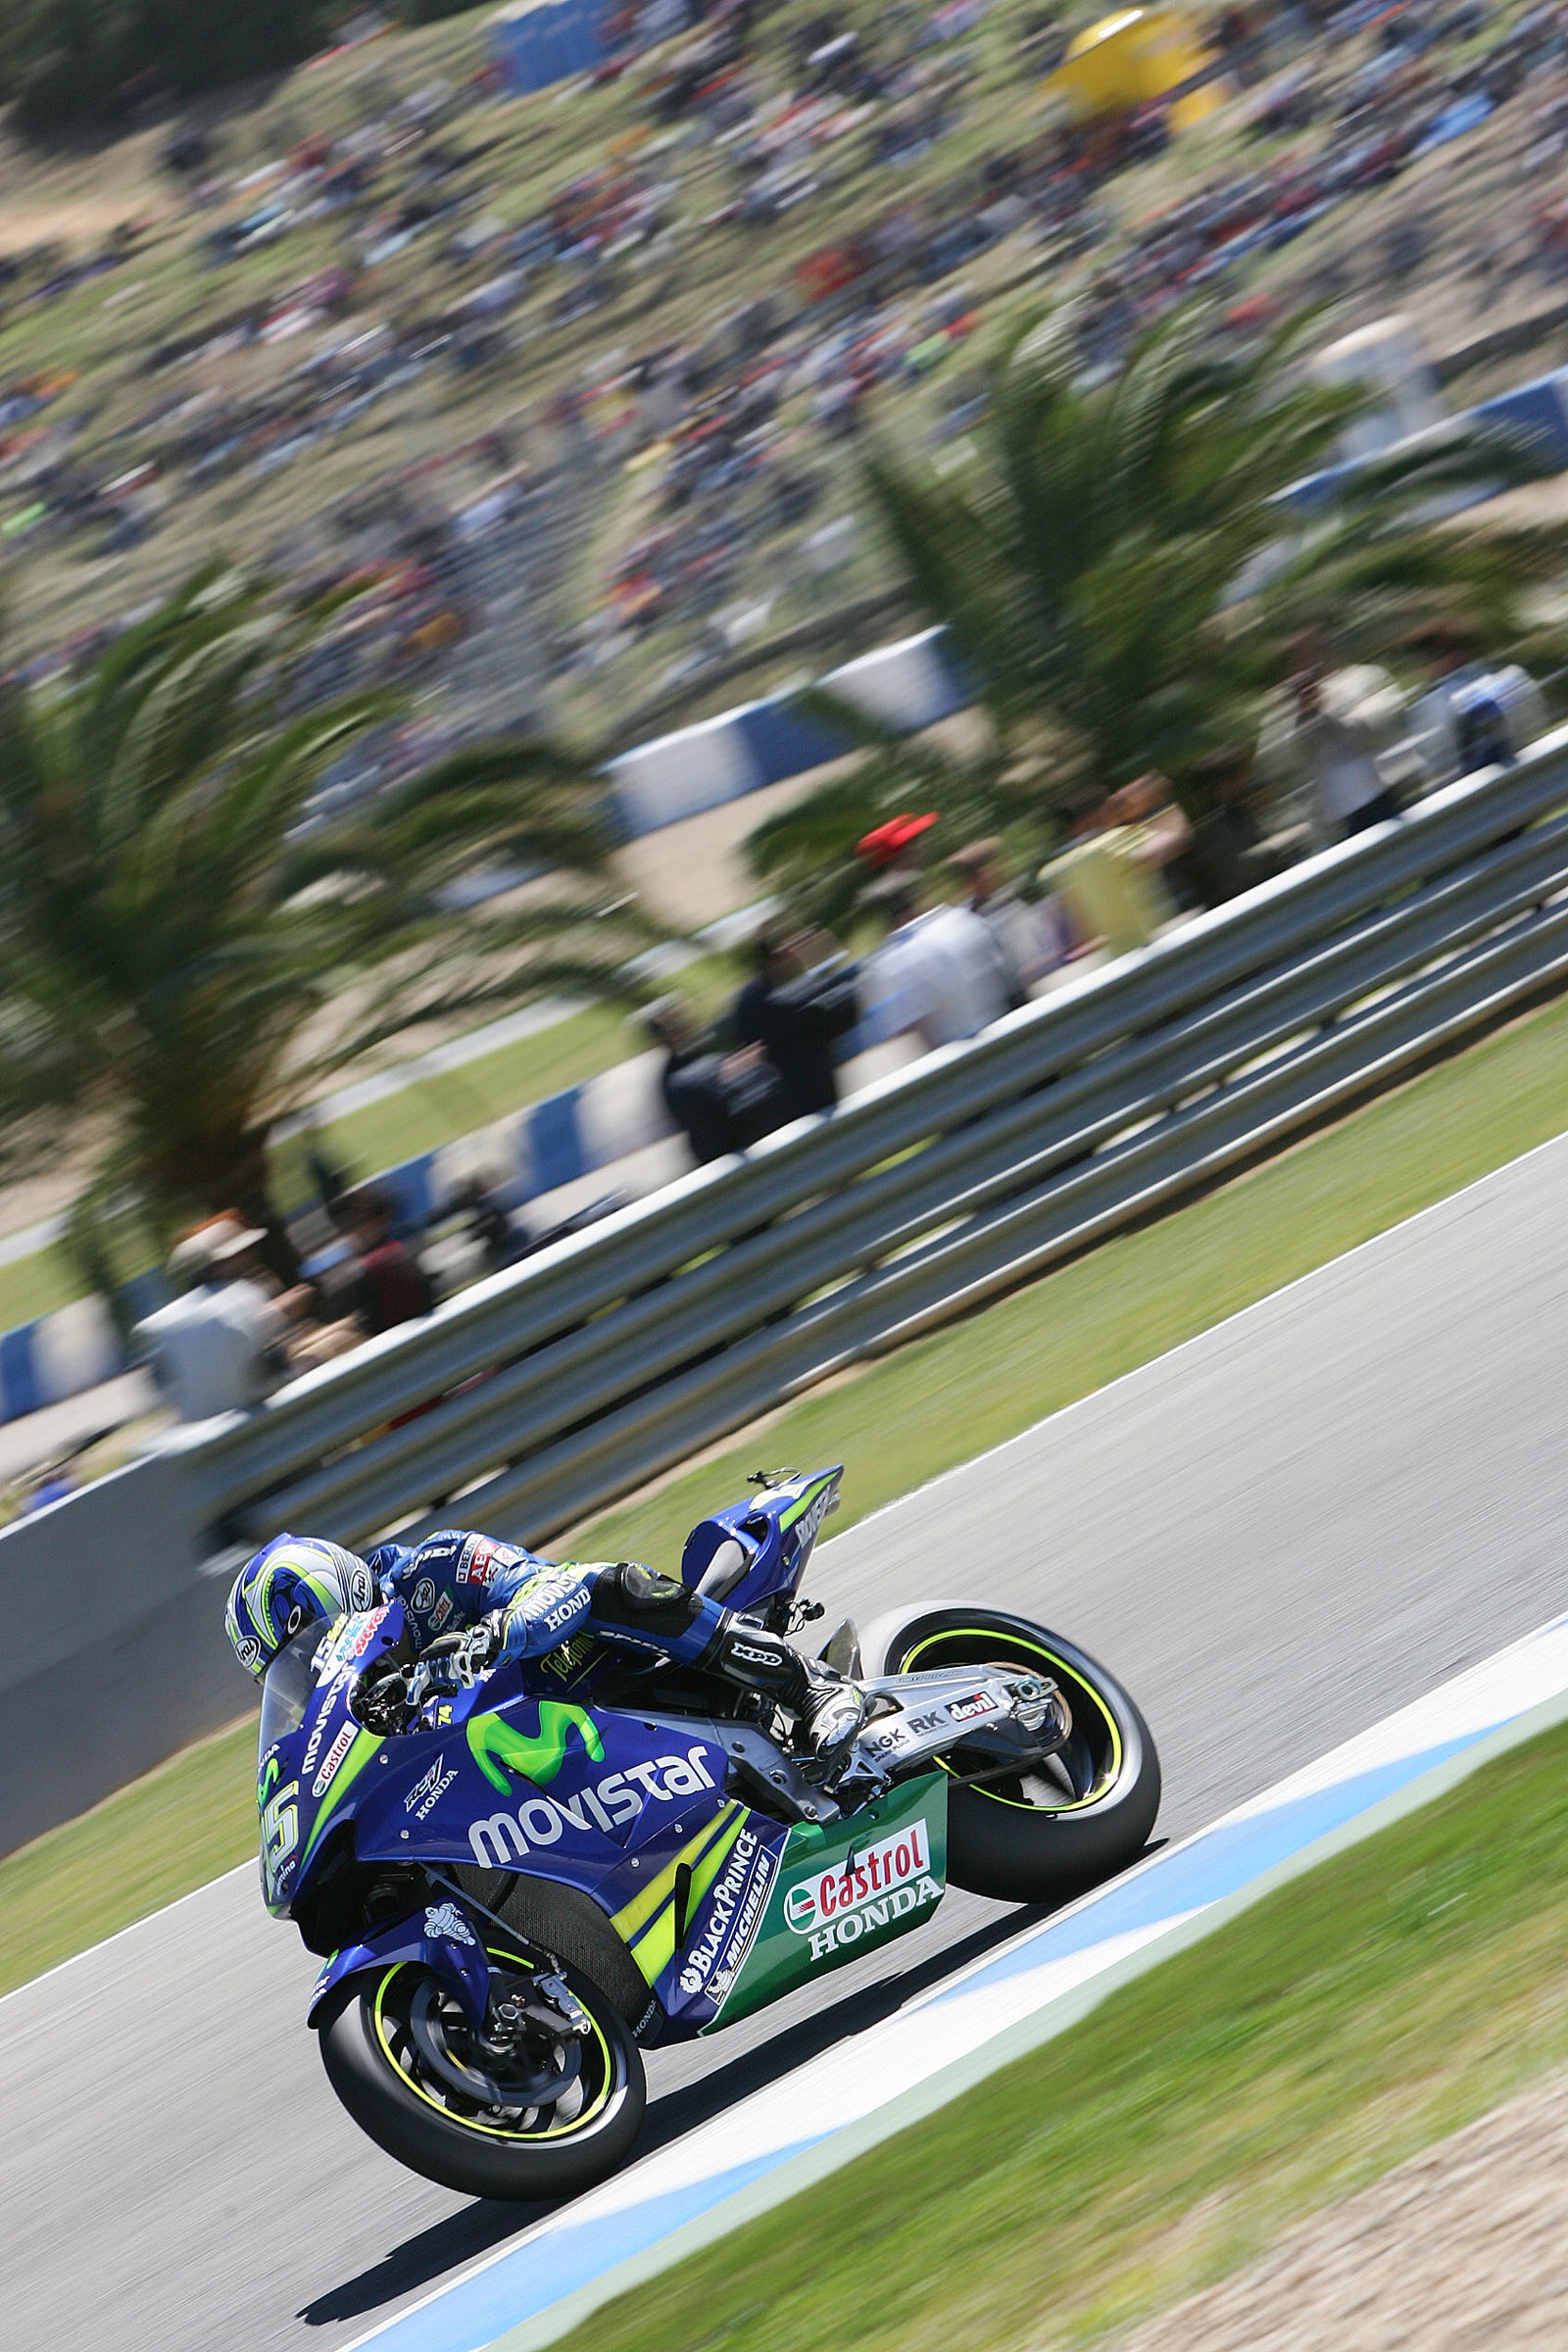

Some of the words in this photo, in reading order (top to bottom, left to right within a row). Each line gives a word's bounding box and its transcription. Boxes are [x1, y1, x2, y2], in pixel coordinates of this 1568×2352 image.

[353, 1575, 367, 1604] Arai
[310, 1637, 334, 1673] 15
[730, 1642, 783, 1666] XPD
[864, 1729, 906, 1758] NGK
[906, 1710, 946, 1735] RK
[951, 1691, 997, 1721] devil
[321, 1731, 352, 1781] Castrol
[416, 1769, 459, 1821] HONDA
[467, 1745, 716, 1869] movistar
[819, 1829, 923, 1917] Castrol
[725, 1853, 772, 1968] MICHELIN
[807, 1875, 946, 1961] HONDA
[631, 1999, 659, 2038] HONDA
